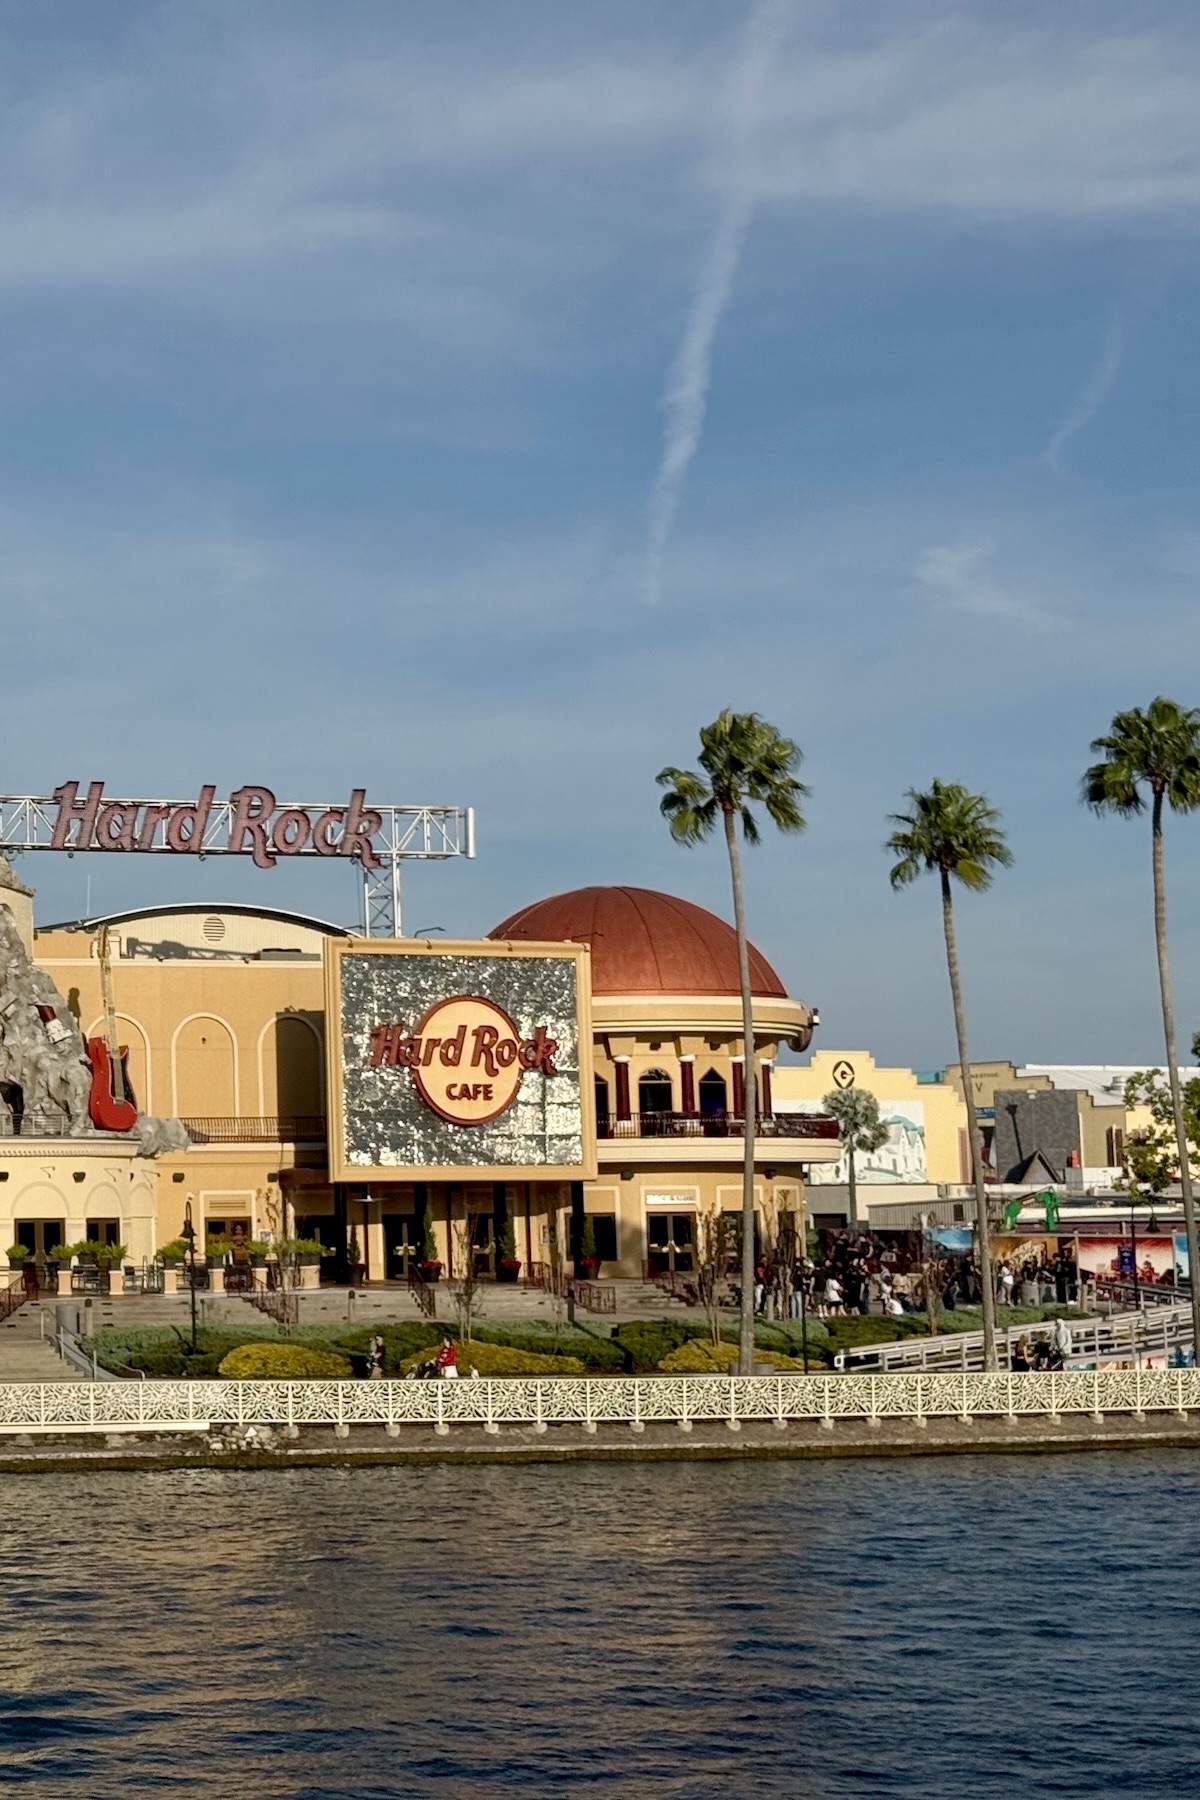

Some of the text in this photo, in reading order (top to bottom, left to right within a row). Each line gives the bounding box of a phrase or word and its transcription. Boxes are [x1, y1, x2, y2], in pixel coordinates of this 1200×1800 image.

[50, 781, 383, 869] Hard Rock
[371, 1024, 560, 1076] Hard Rock
[445, 1083, 494, 1101] CAFE
